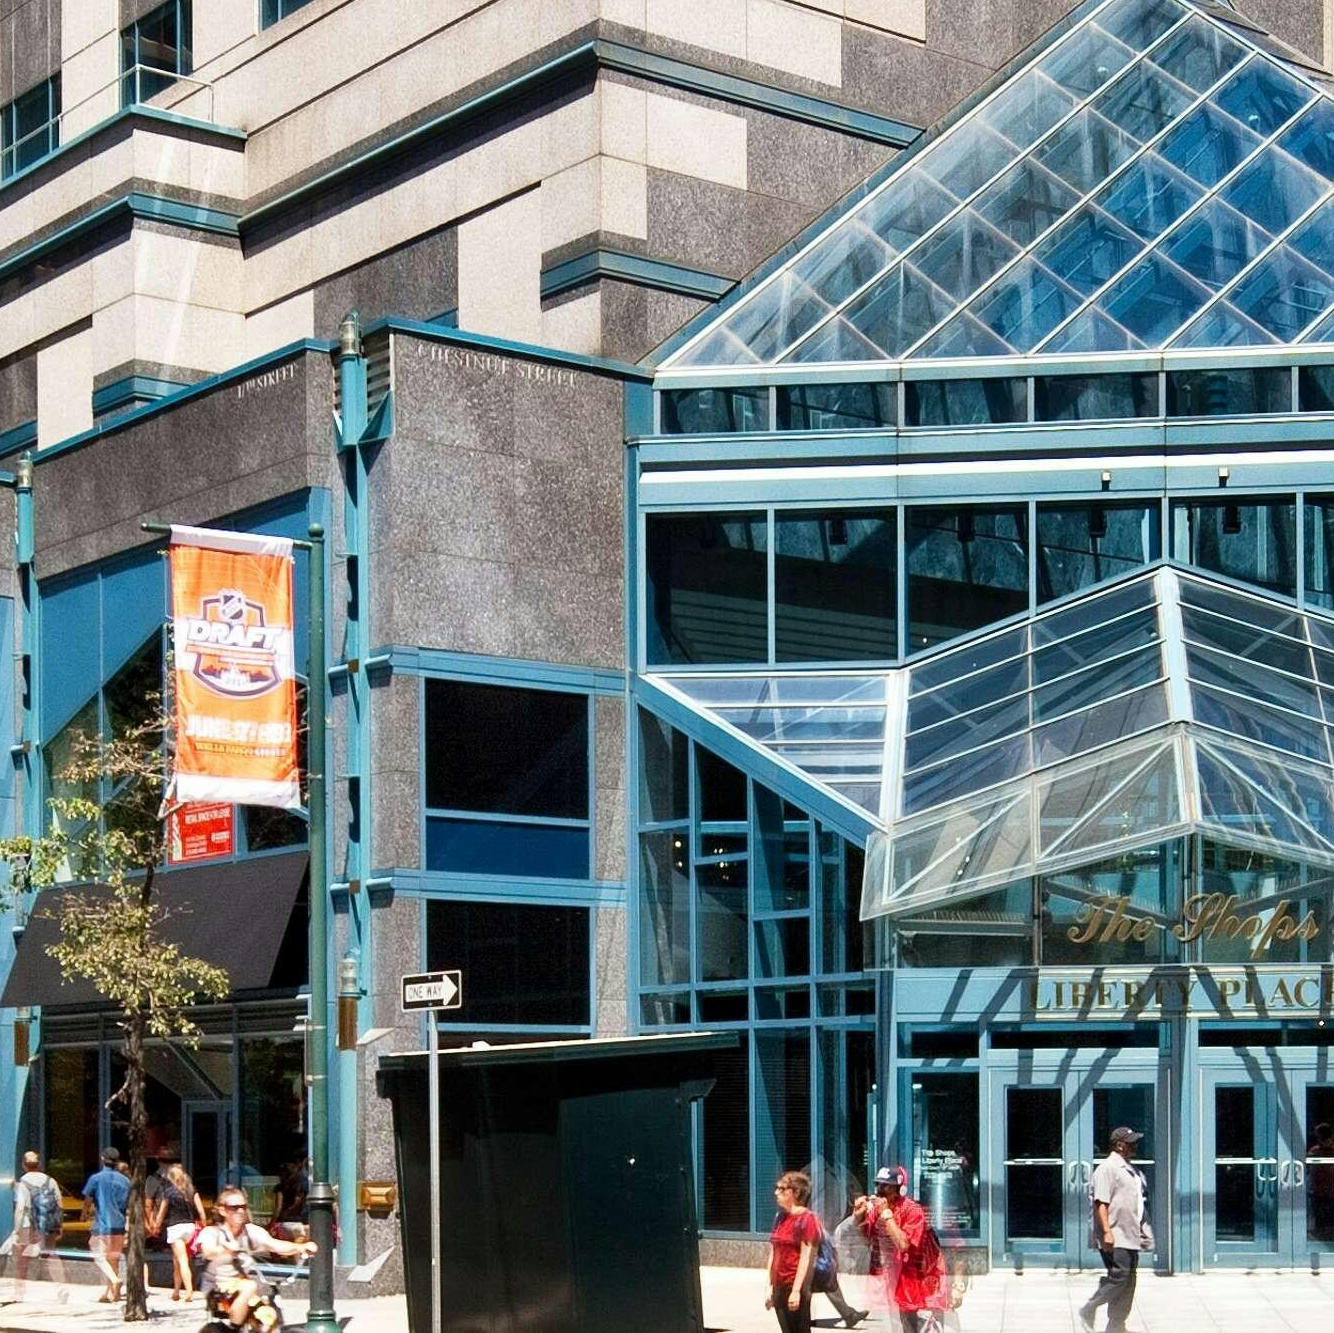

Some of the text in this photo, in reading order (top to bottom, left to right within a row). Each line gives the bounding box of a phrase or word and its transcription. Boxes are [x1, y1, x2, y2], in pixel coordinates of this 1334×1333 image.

[187, 618, 284, 650] DRAFT
[1067, 892, 1320, 959] The Shops
[407, 984, 442, 1000] ONE WAY
[1030, 977, 1199, 1010] LIBERTY
